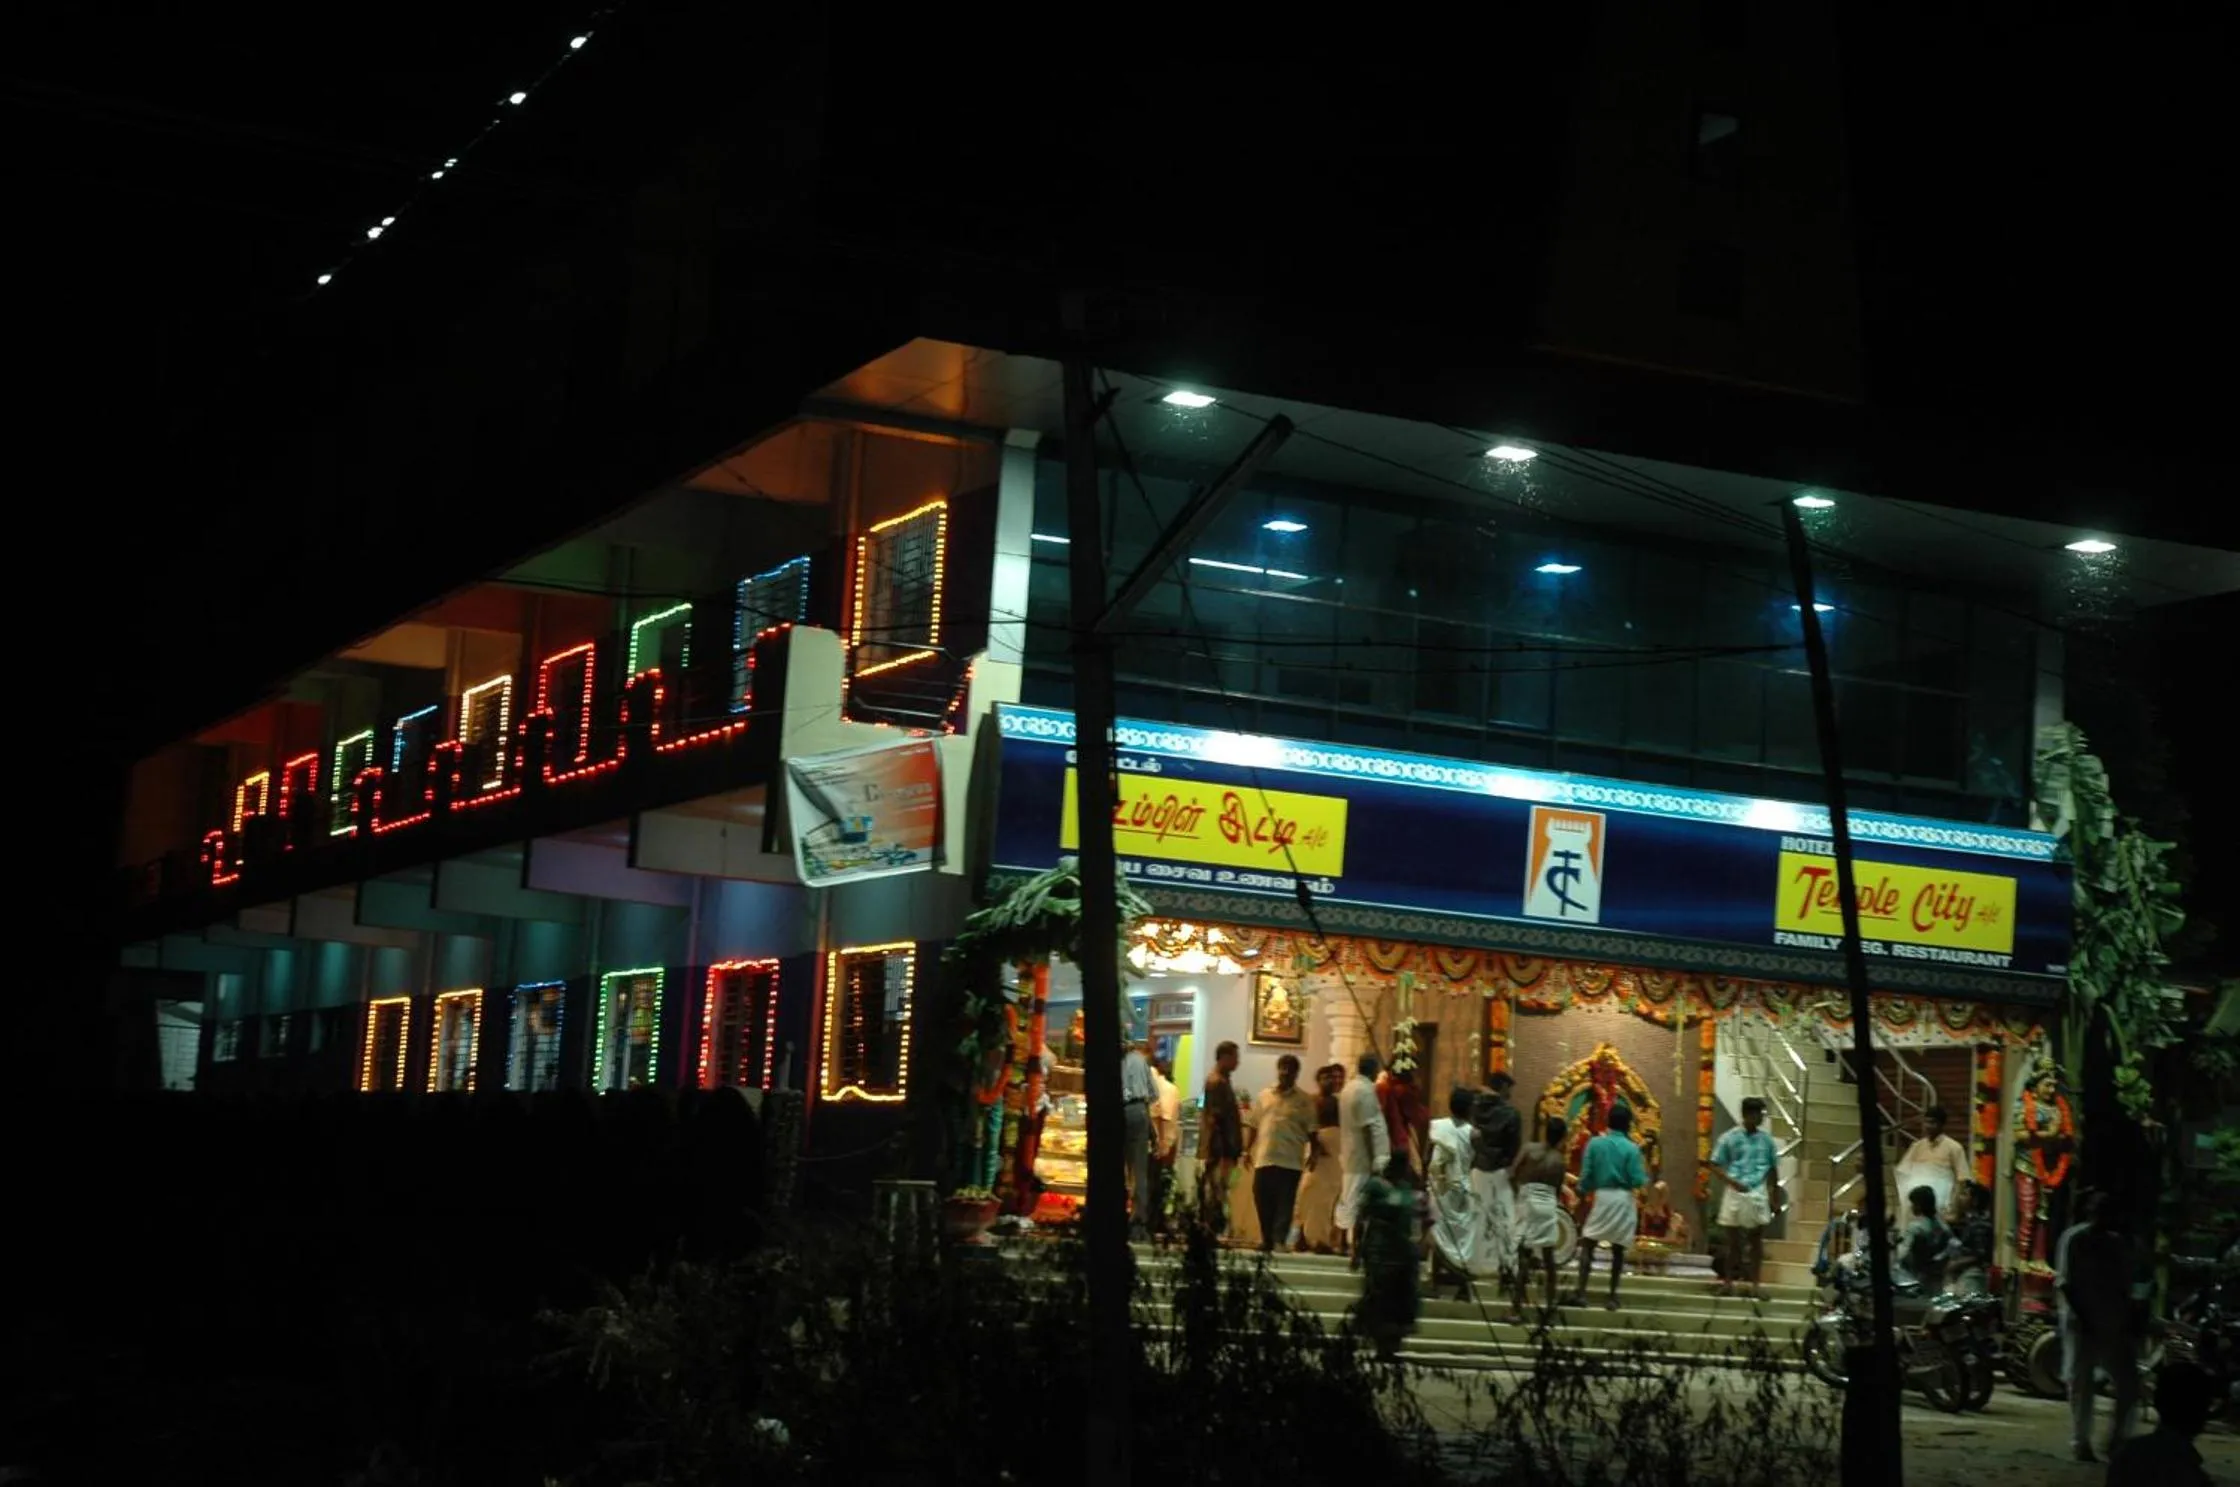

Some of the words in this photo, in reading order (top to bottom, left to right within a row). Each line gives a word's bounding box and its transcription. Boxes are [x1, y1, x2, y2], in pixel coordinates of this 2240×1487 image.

[1780, 836, 1838, 857] HOTEL
[1215, 871, 1336, 894] உணவம்
[1794, 866, 1900, 921] Teple
[1911, 883, 1976, 932] City
[1774, 932, 1843, 951] FAMILY
[1891, 943, 2014, 968] RESTAURANT
